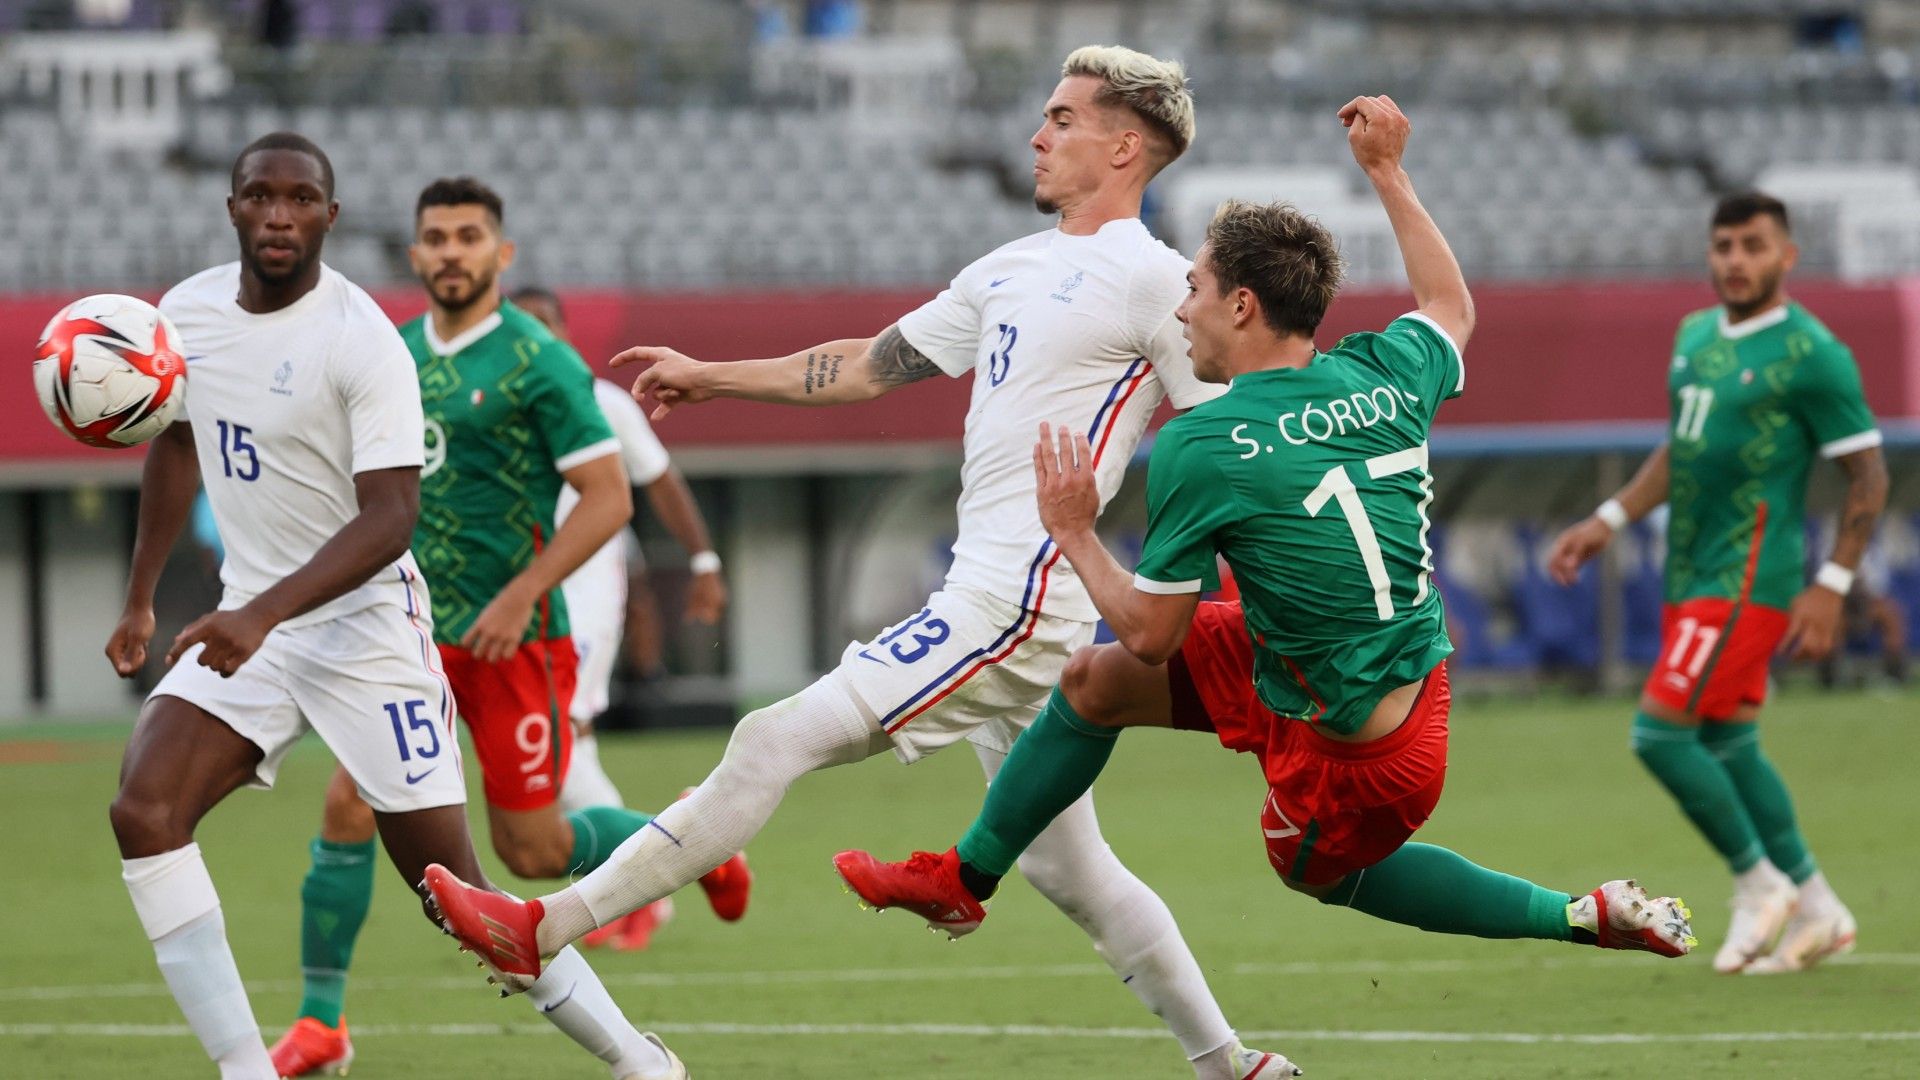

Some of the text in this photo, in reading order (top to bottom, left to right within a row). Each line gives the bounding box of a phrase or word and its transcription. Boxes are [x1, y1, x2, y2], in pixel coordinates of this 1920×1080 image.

[988, 323, 1017, 388] 13
[1231, 423, 1274, 460] S.
[1676, 384, 1715, 441] 11
[217, 419, 260, 482] 15
[420, 417, 448, 479] 9
[1302, 439, 1435, 621] 17
[878, 608, 950, 664] 13
[1668, 616, 1720, 678] 11
[383, 699, 440, 762] 15
[514, 711, 551, 774] 9
